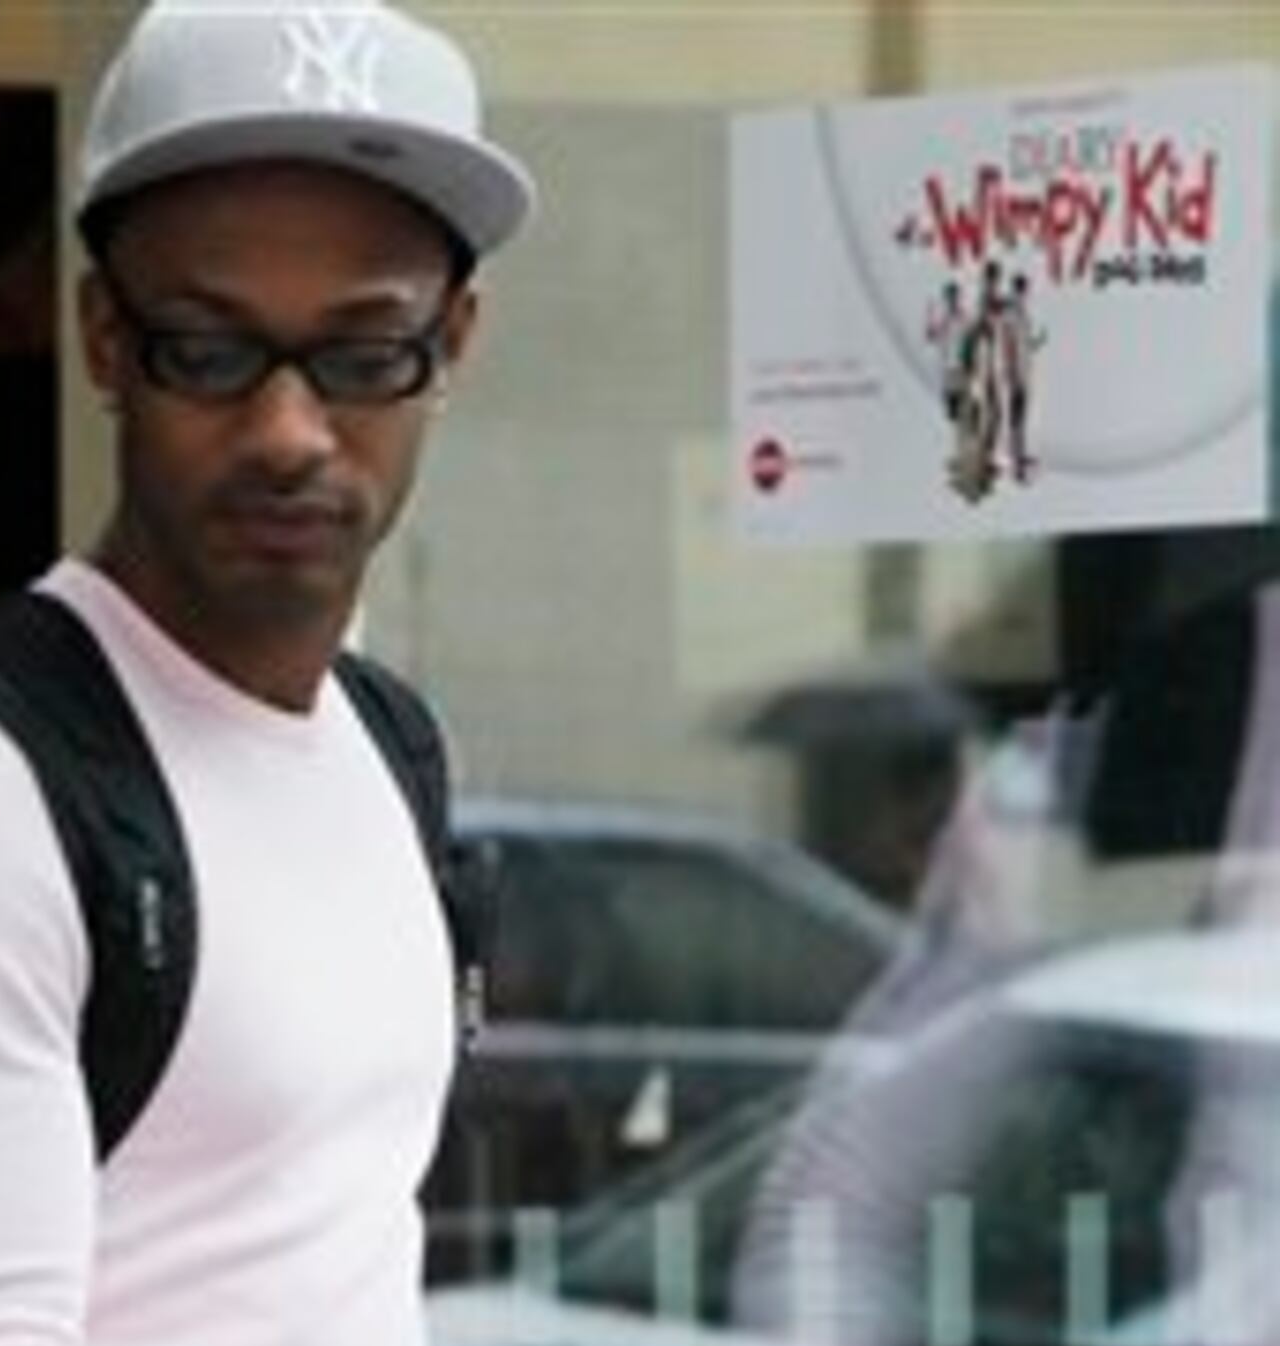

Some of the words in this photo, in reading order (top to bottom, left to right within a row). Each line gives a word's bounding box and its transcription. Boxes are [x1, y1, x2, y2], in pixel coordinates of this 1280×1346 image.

[280, 8, 380, 112] NY
[924, 160, 1113, 284] Wimpy
[1120, 136, 1217, 248] Kid
